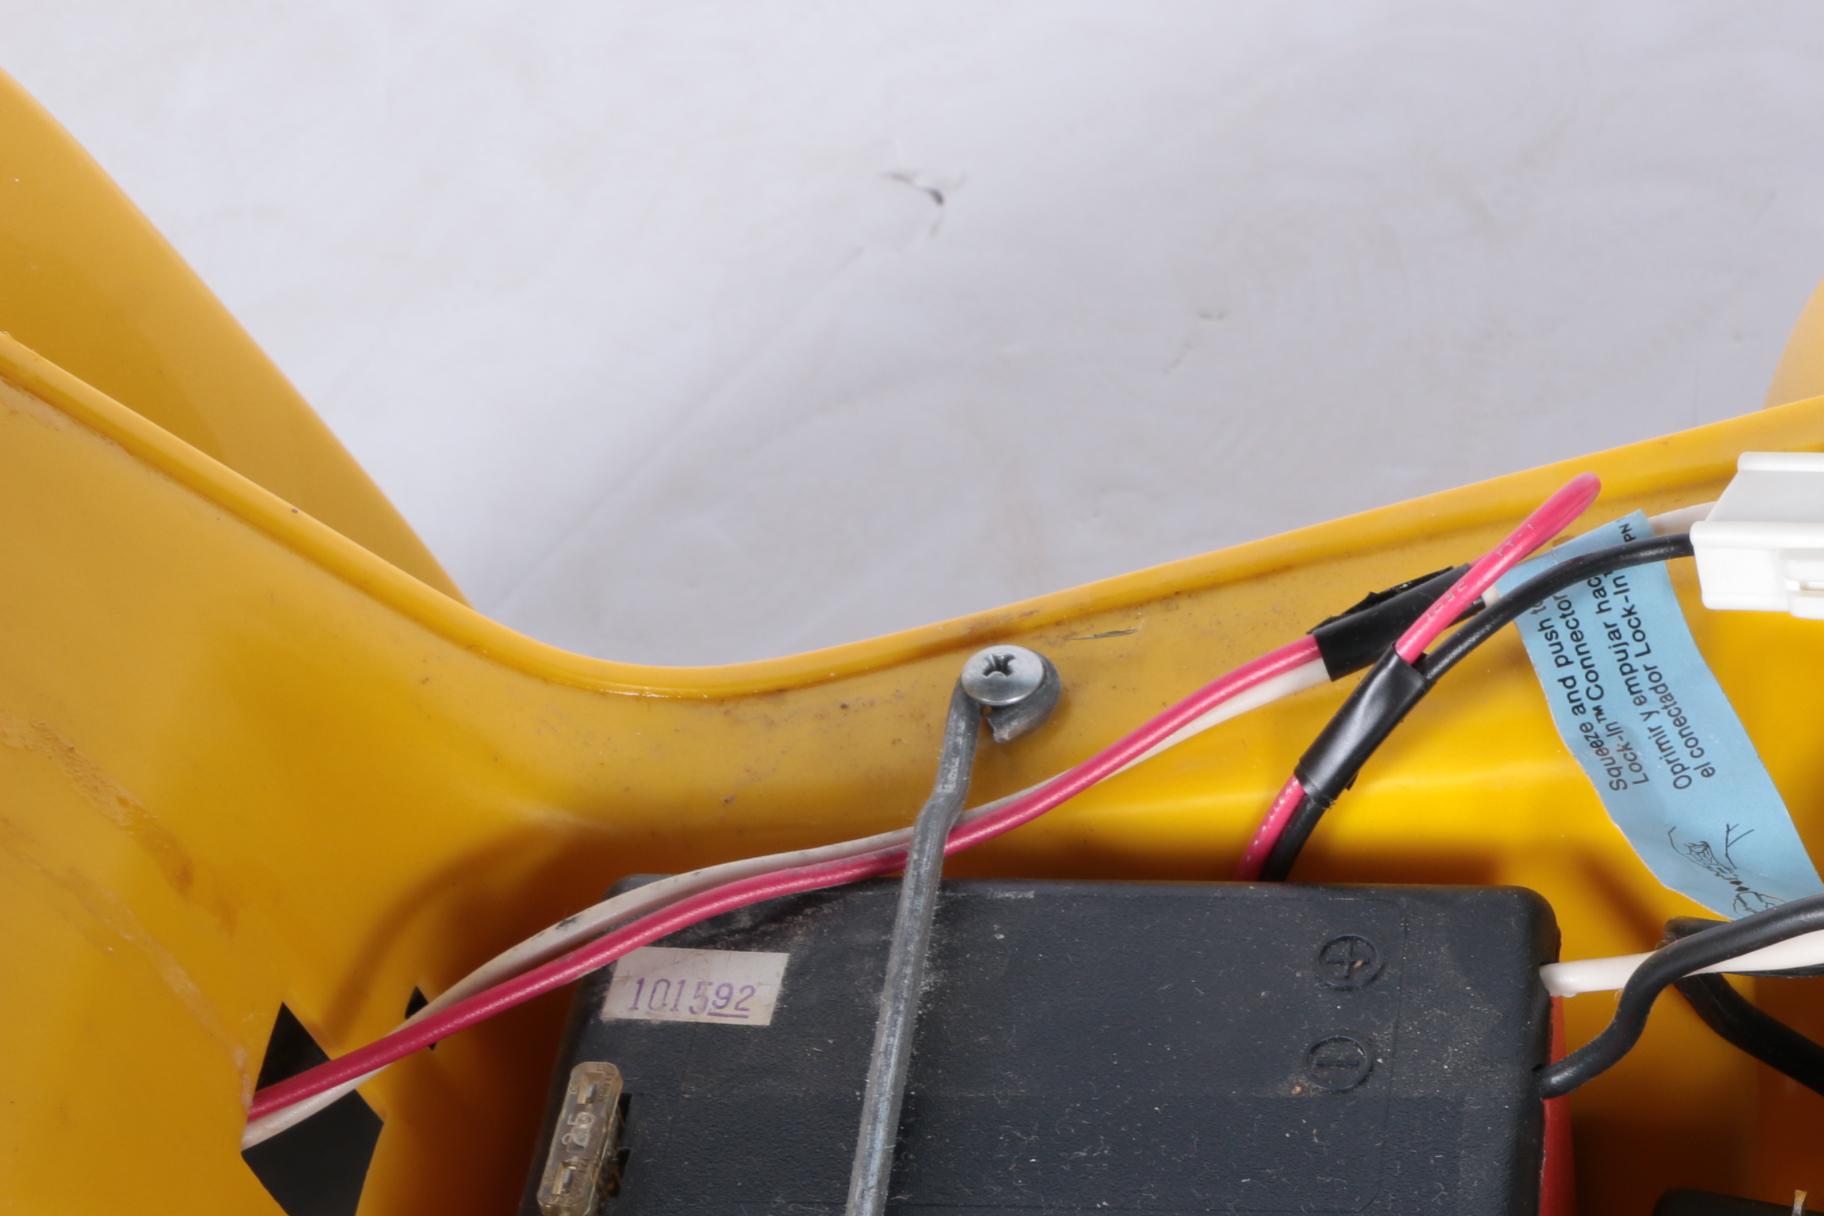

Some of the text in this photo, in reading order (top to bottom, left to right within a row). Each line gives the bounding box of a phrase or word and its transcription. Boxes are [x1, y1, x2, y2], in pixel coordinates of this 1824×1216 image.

[1619, 523, 1637, 543] PN
[1537, 615, 1574, 669] push
[1552, 593, 1605, 704] Connector
[1557, 674, 1586, 718] and
[1586, 576, 1692, 790] Oprimir y empujar hac
[1645, 664, 1705, 761] conectador
[1578, 721, 1627, 792] Squeeze
[1698, 765, 1716, 779] el
[628, 976, 757, 1017] 101592
